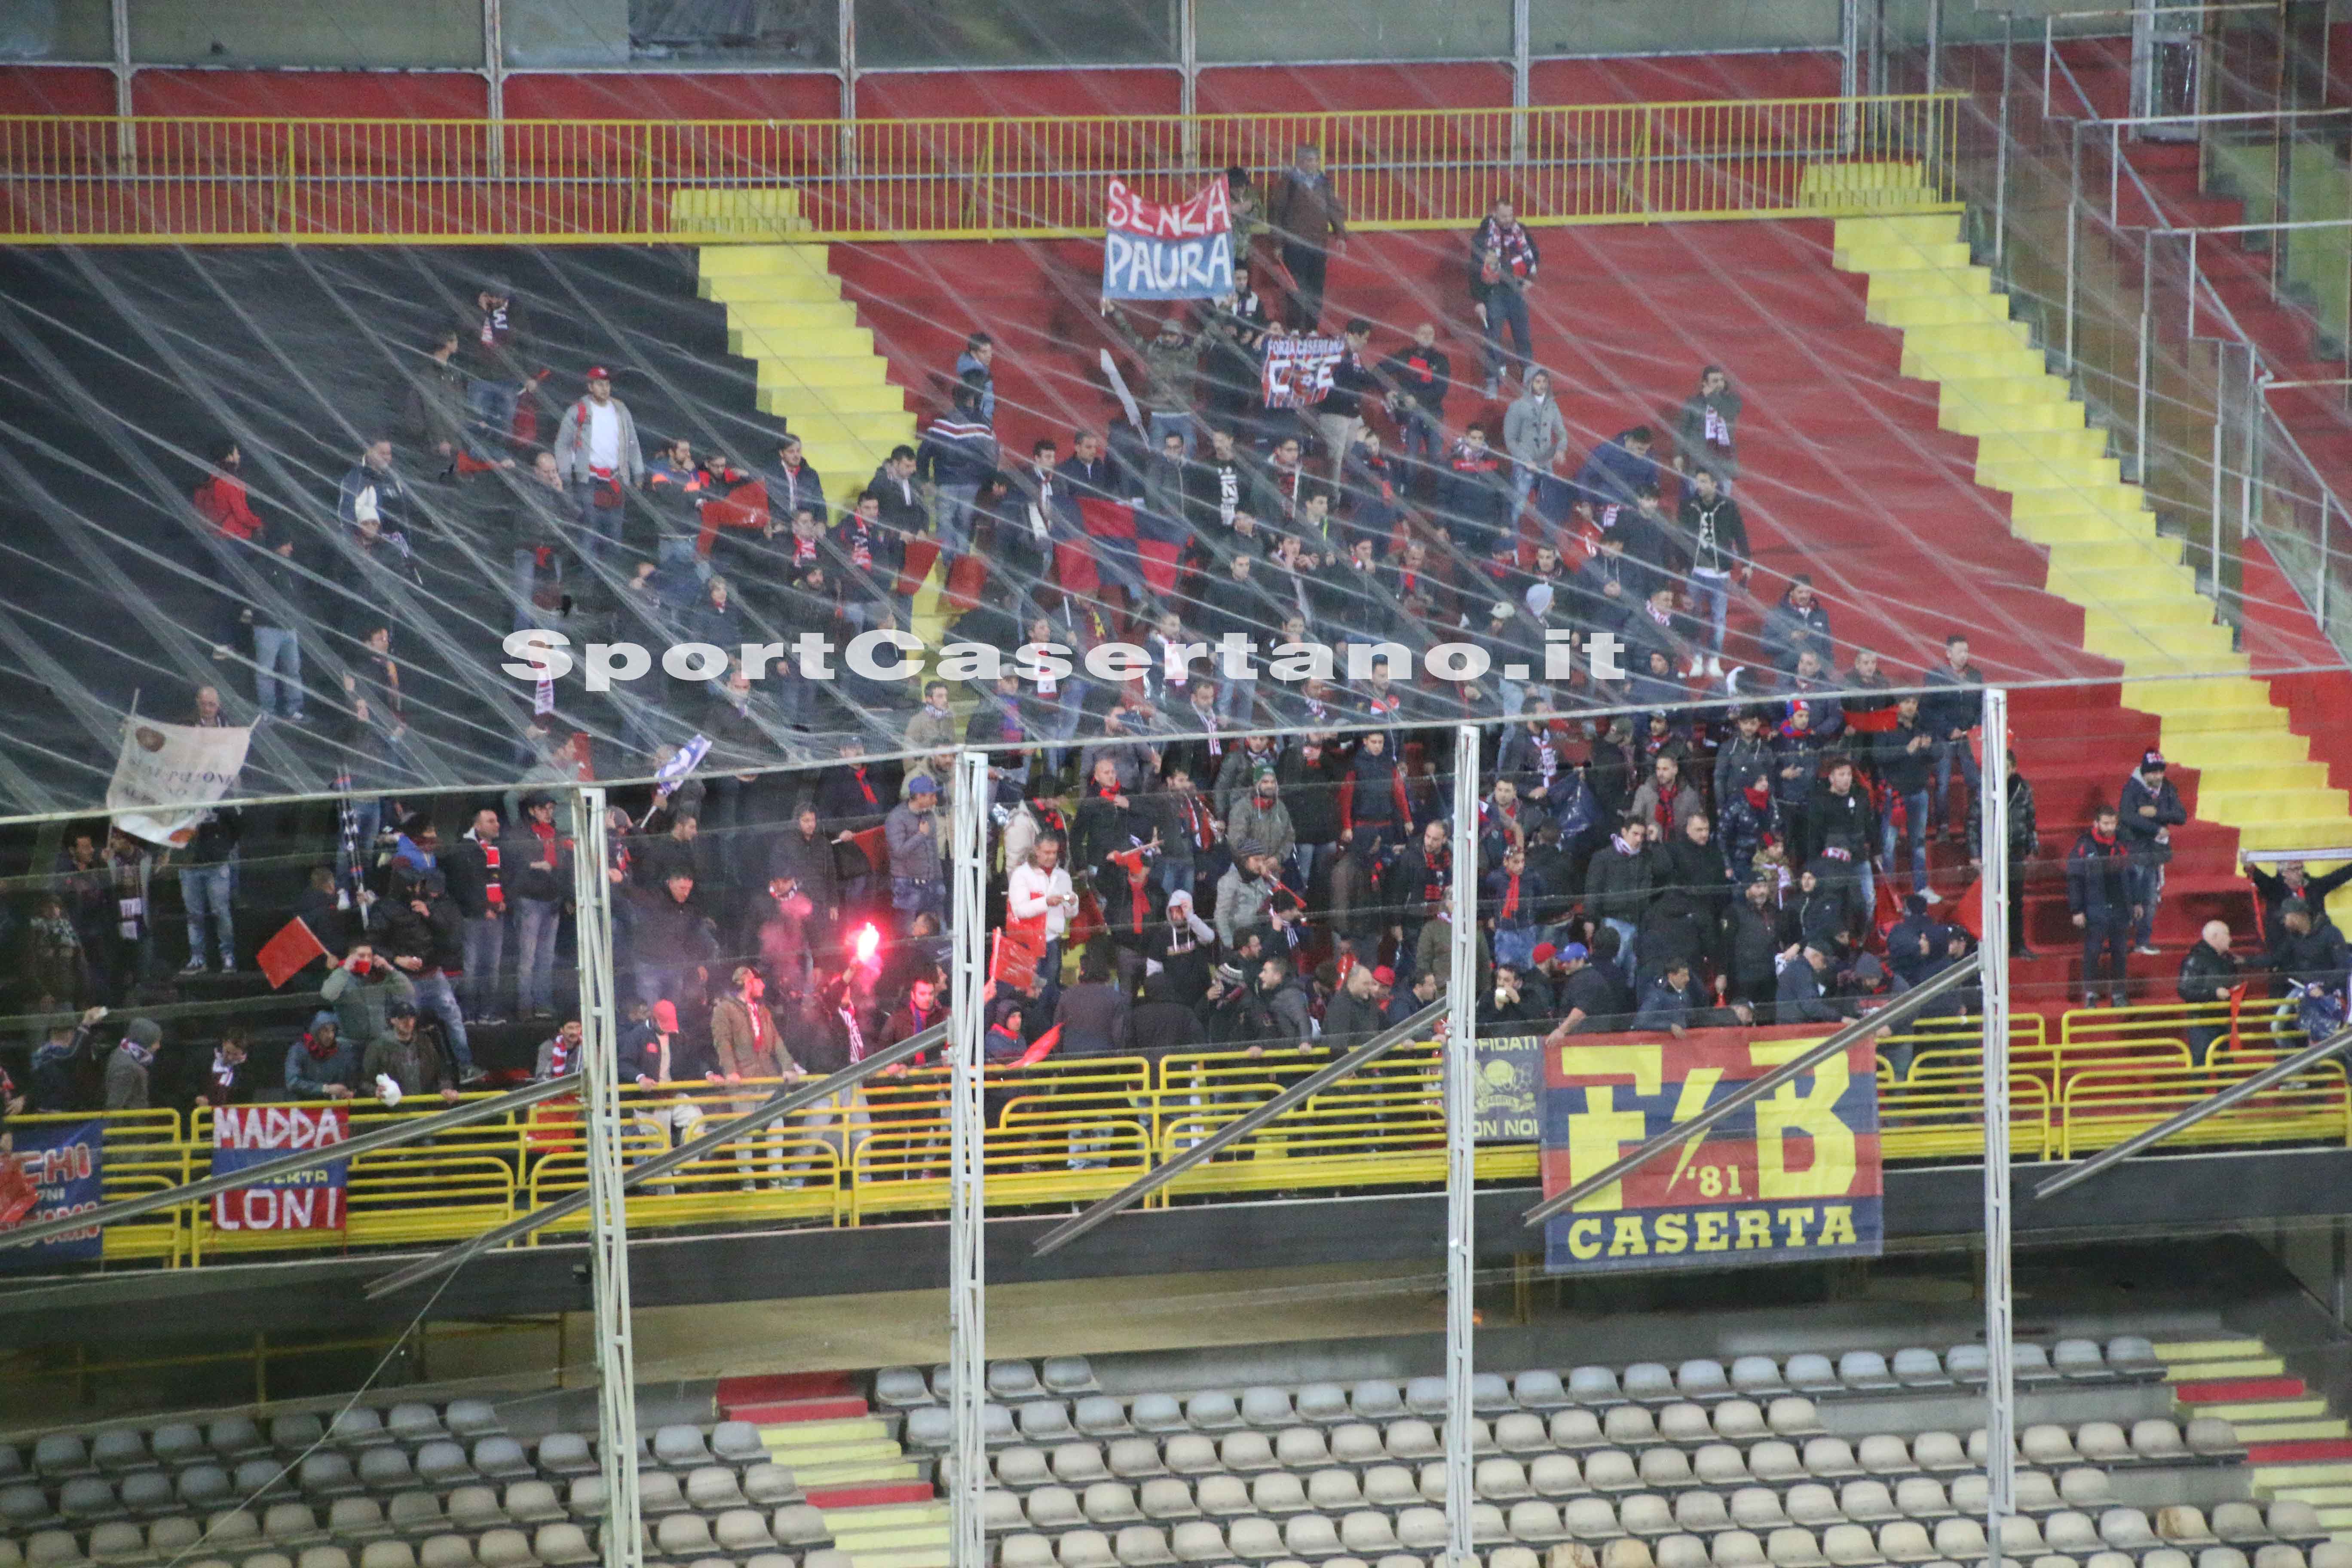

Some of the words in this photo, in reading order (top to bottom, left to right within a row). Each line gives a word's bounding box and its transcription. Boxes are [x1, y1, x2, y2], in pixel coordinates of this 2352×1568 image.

[1107, 179, 1232, 236] SENZA
[1108, 232, 1233, 292] PAURA
[213, 1107, 342, 1148] MADDA
[1505, 1118, 1539, 1136] NOI
[1687, 1165, 1742, 1197] '81
[216, 1187, 337, 1230] LONI
[1568, 1205, 1857, 1260] CASERTA
